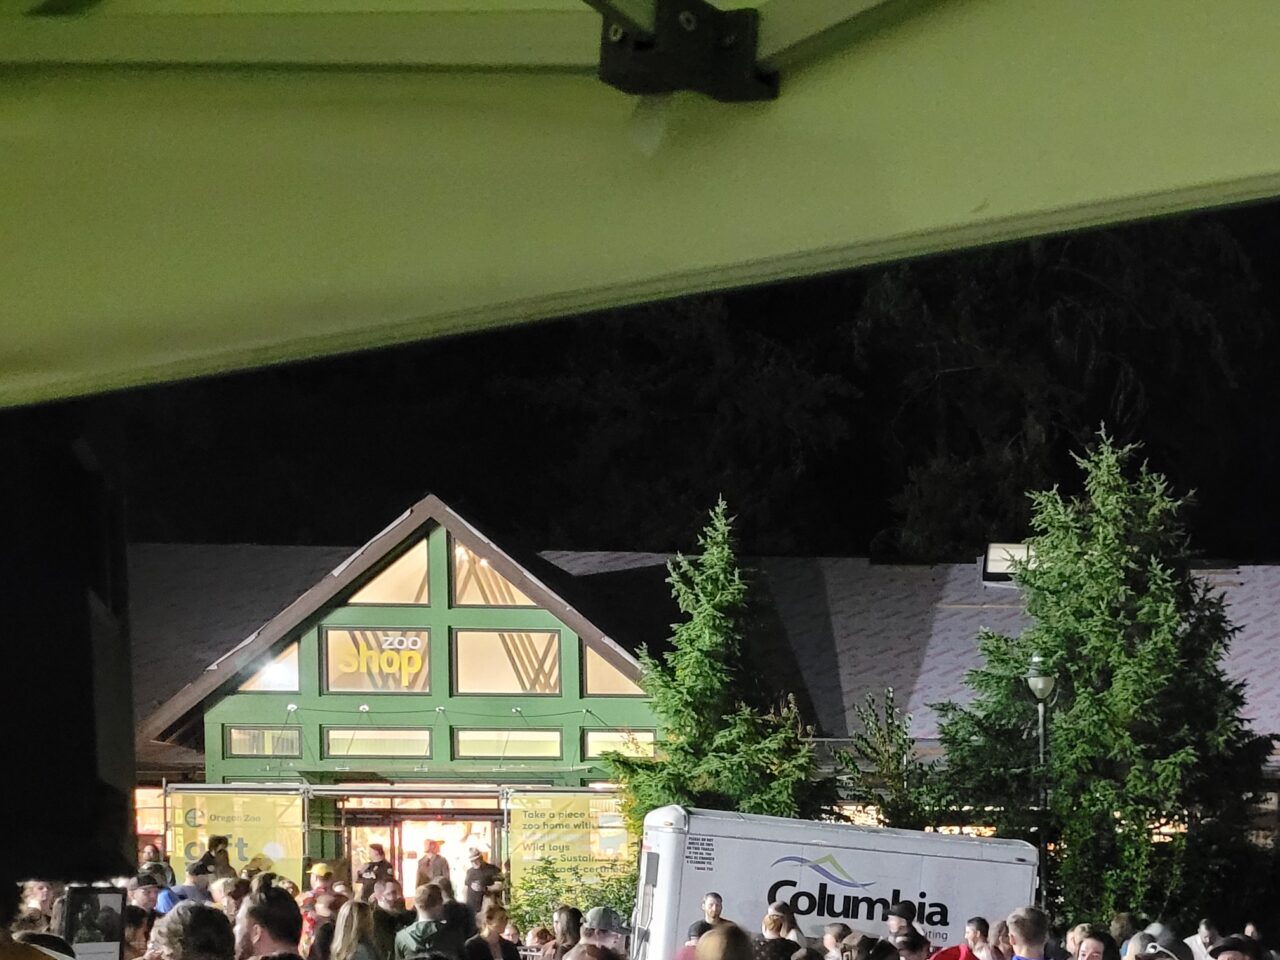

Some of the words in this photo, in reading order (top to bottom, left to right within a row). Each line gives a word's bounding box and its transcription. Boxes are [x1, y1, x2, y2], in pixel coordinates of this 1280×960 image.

[382, 636, 421, 650] zoo
[338, 641, 422, 688] shop
[209, 814, 242, 823] Oregon
[244, 813, 261, 823] Zoo
[522, 809, 546, 819] Take
[558, 810, 585, 821] piece
[522, 822, 540, 830] zoo
[543, 821, 570, 830] home
[522, 842, 546, 852] Wild
[549, 844, 570, 853] toys
